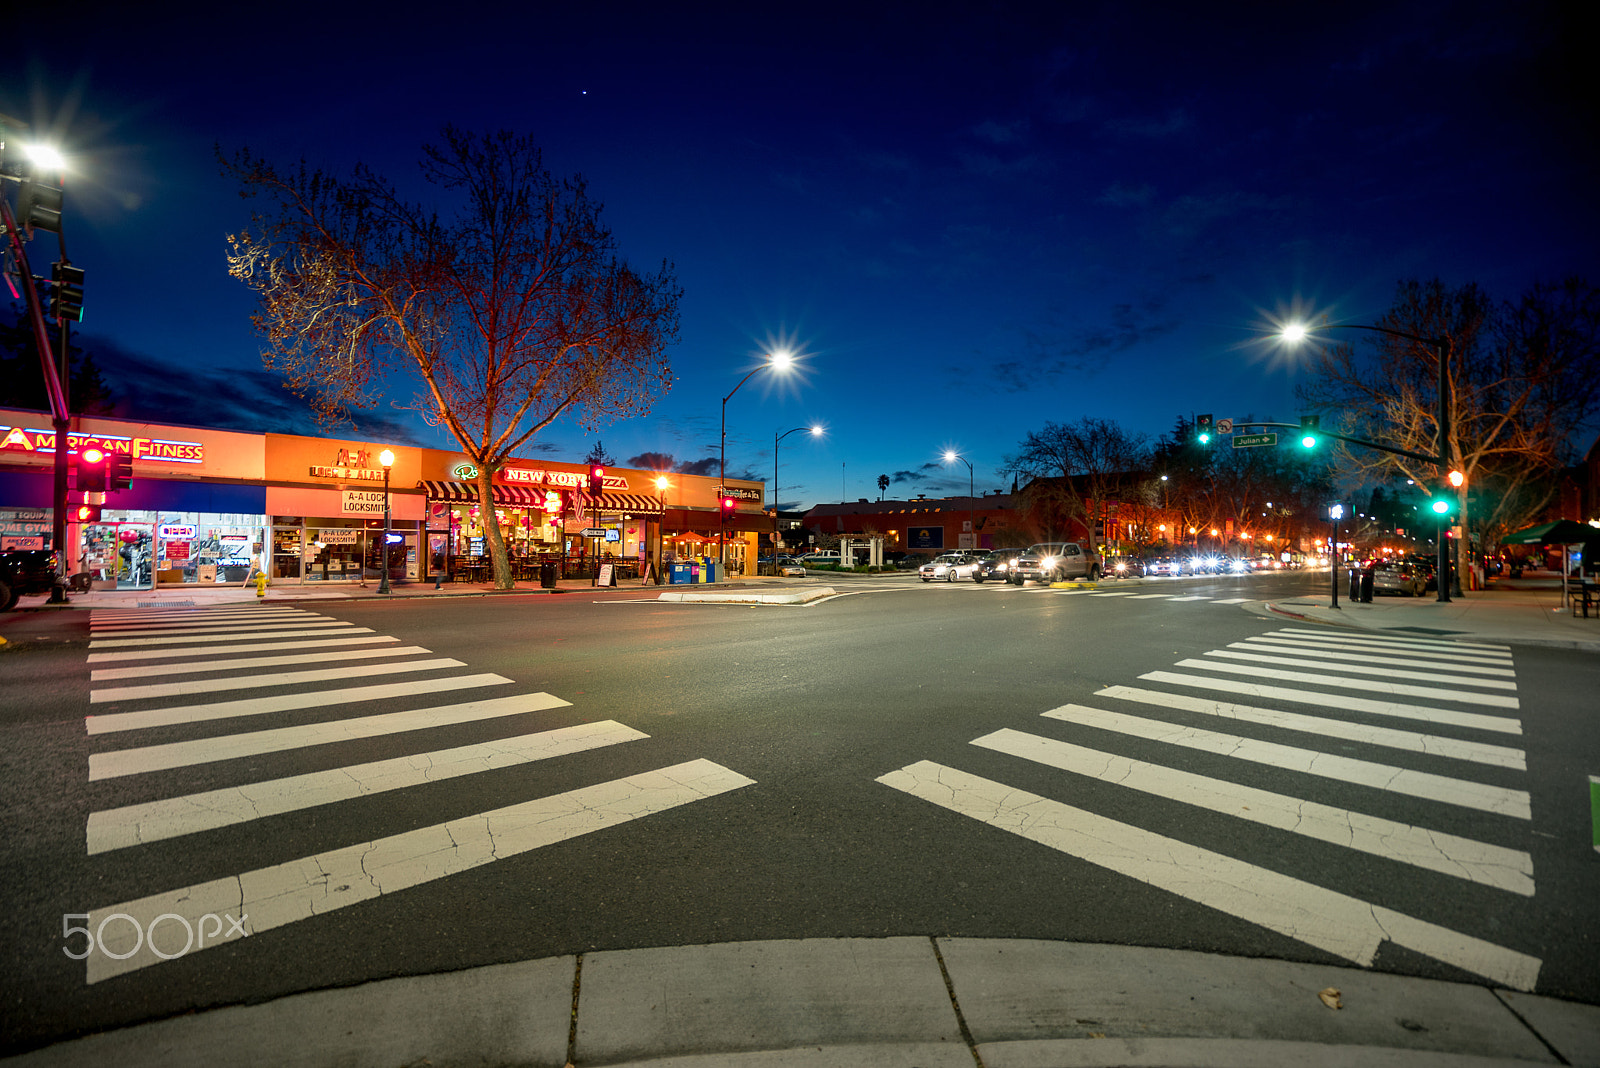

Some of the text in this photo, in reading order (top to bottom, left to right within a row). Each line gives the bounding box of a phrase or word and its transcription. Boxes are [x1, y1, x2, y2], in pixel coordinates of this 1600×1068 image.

[0, 428, 203, 459] AMRICAN FITNESS
[1238, 437, 1261, 445] Julian
[337, 448, 367, 468] A-A
[506, 469, 545, 482] NEW
[548, 471, 587, 487] YORK
[348, 492, 386, 502] A-A LOCK
[344, 502, 390, 512] LOCKSMIT
[217, 558, 250, 567] VECTRA
